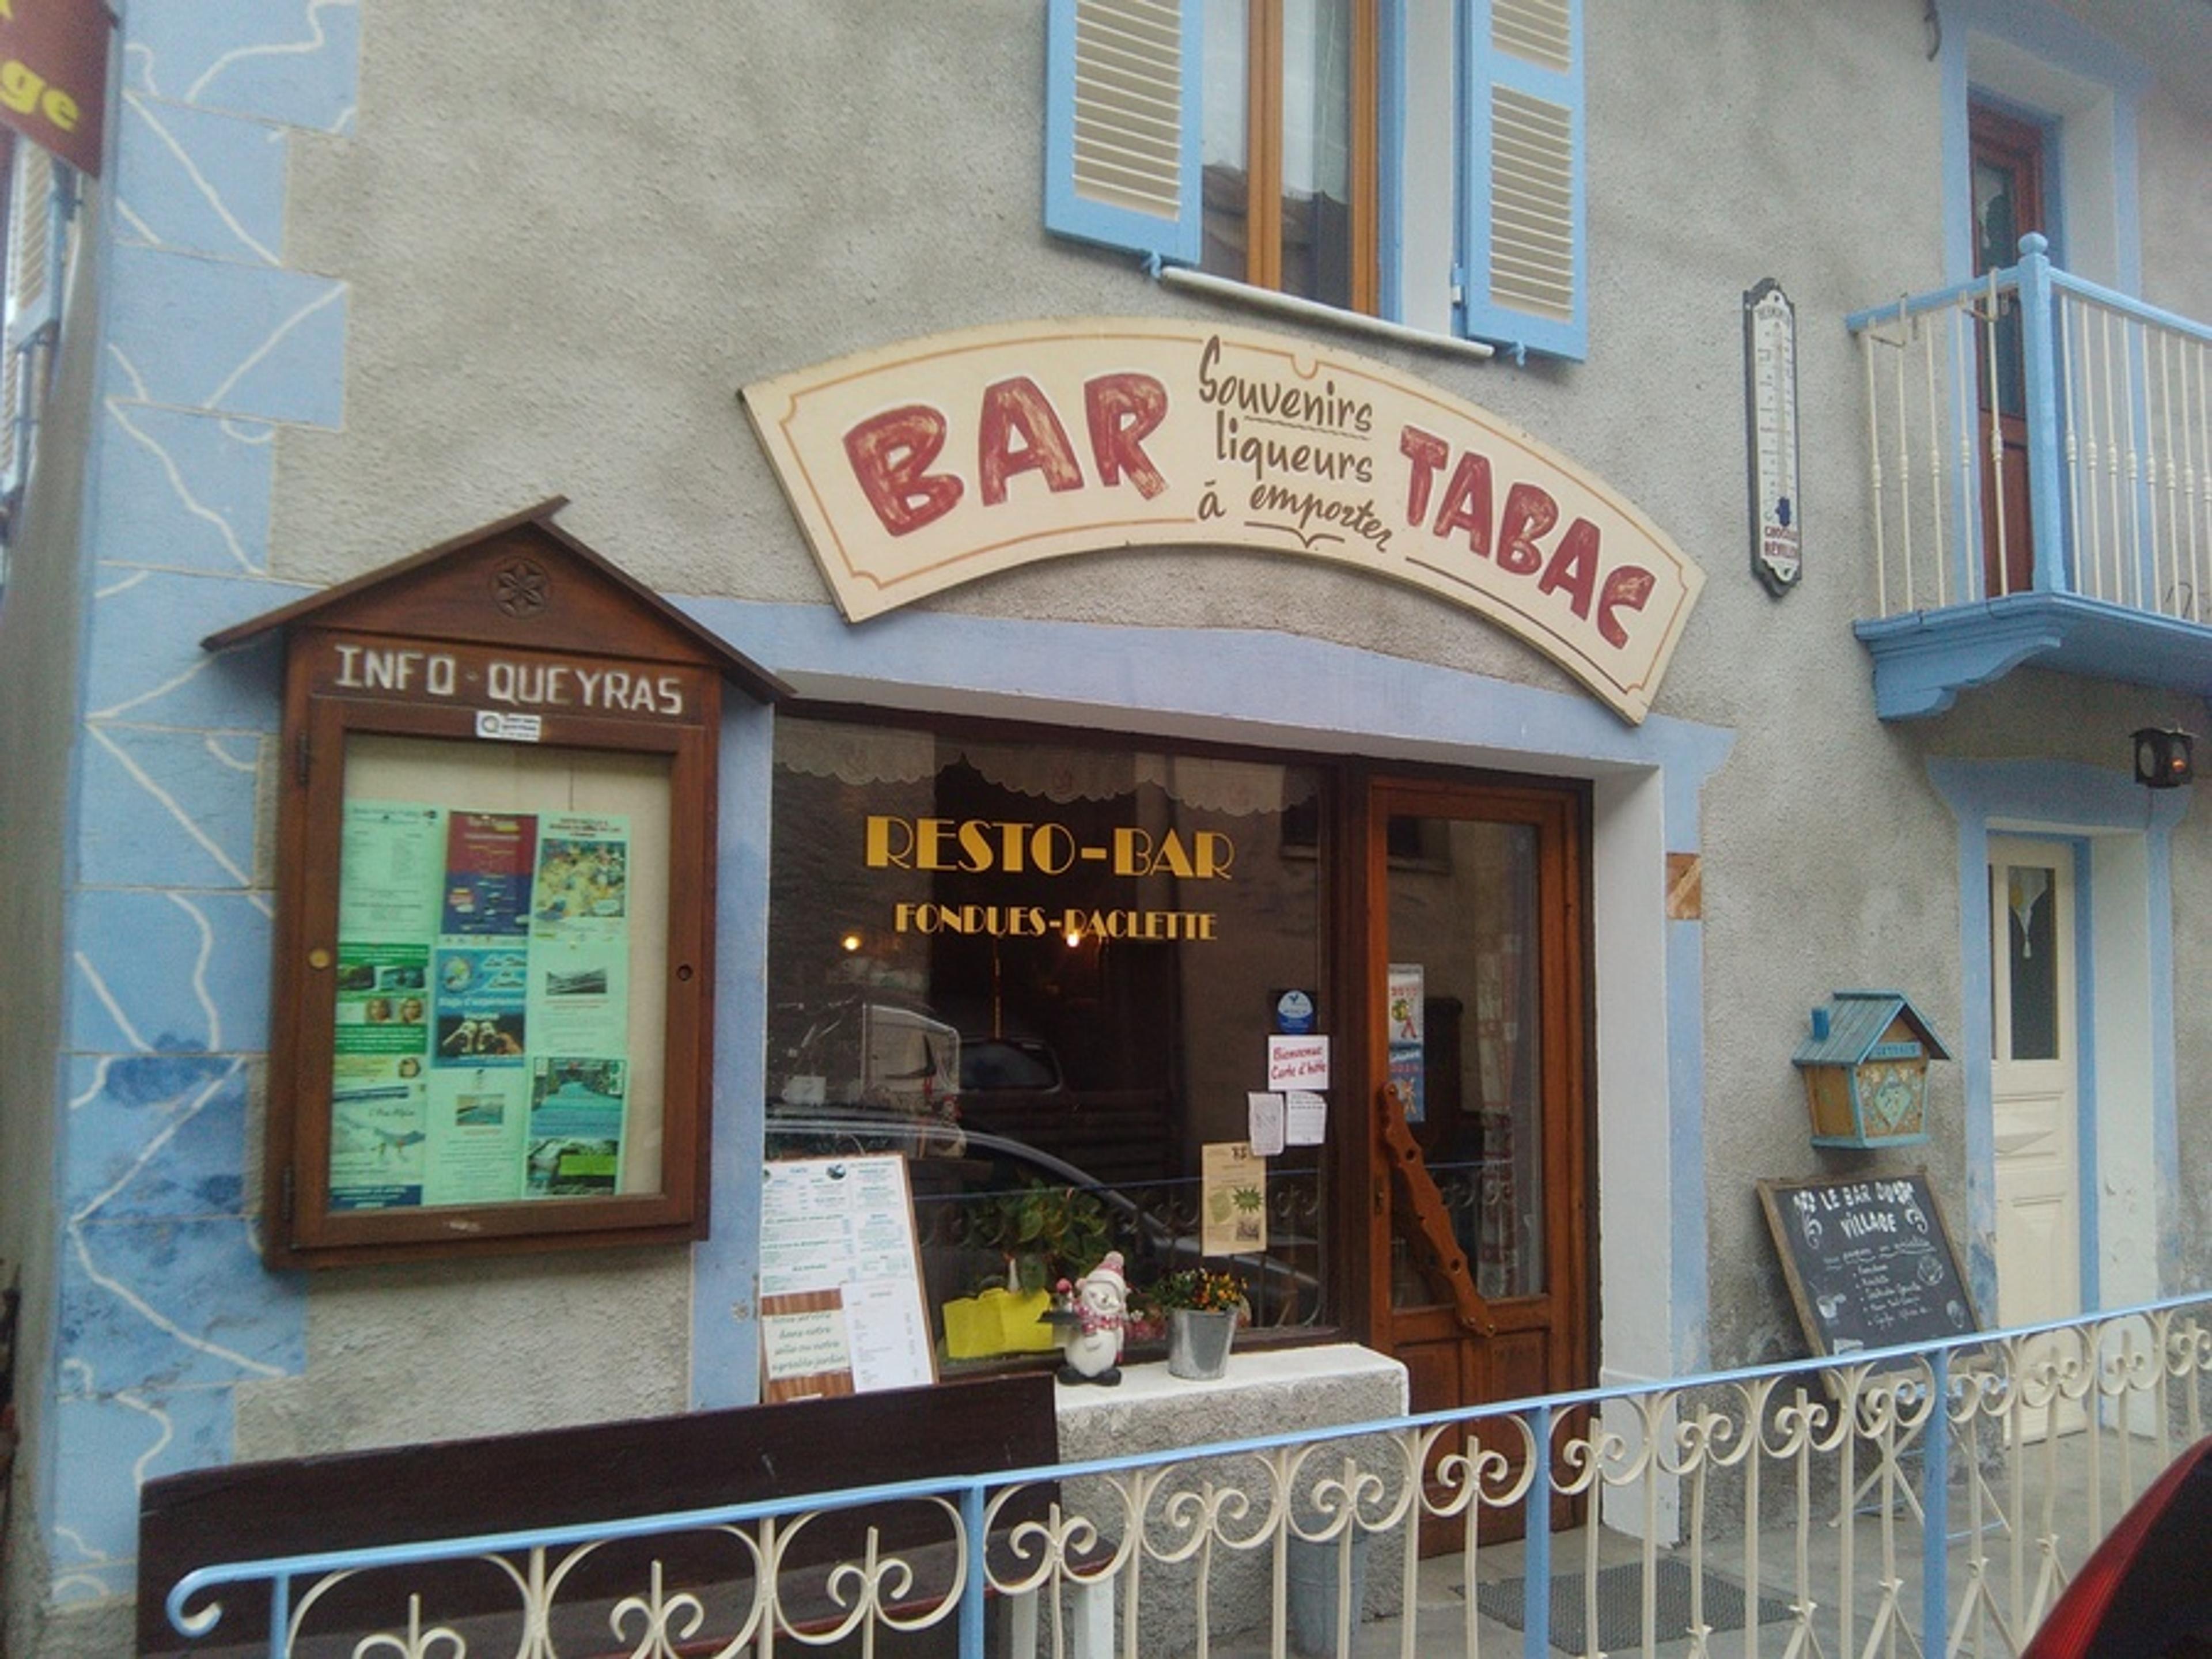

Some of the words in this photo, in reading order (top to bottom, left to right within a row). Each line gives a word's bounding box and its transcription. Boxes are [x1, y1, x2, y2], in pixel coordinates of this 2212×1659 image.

[1199, 334, 1372, 432] Souvenirs
[842, 372, 1169, 538] BAR
[1216, 409, 1372, 483] liqueurs
[1249, 484, 1392, 553] emporter
[1398, 424, 1657, 650] TABAC
[334, 644, 456, 695] INFO
[488, 662, 684, 715] QUEYRAS
[867, 816, 1234, 880] RESTO-BAR
[895, 902, 1217, 941] FONDUES-RACLETTE
[1270, 1064, 1296, 1081] Carte
[1274, 1046, 1323, 1060] Bienvenue
[1819, 1188, 1840, 1211] LE
[1842, 1184, 1872, 1207] BAR
